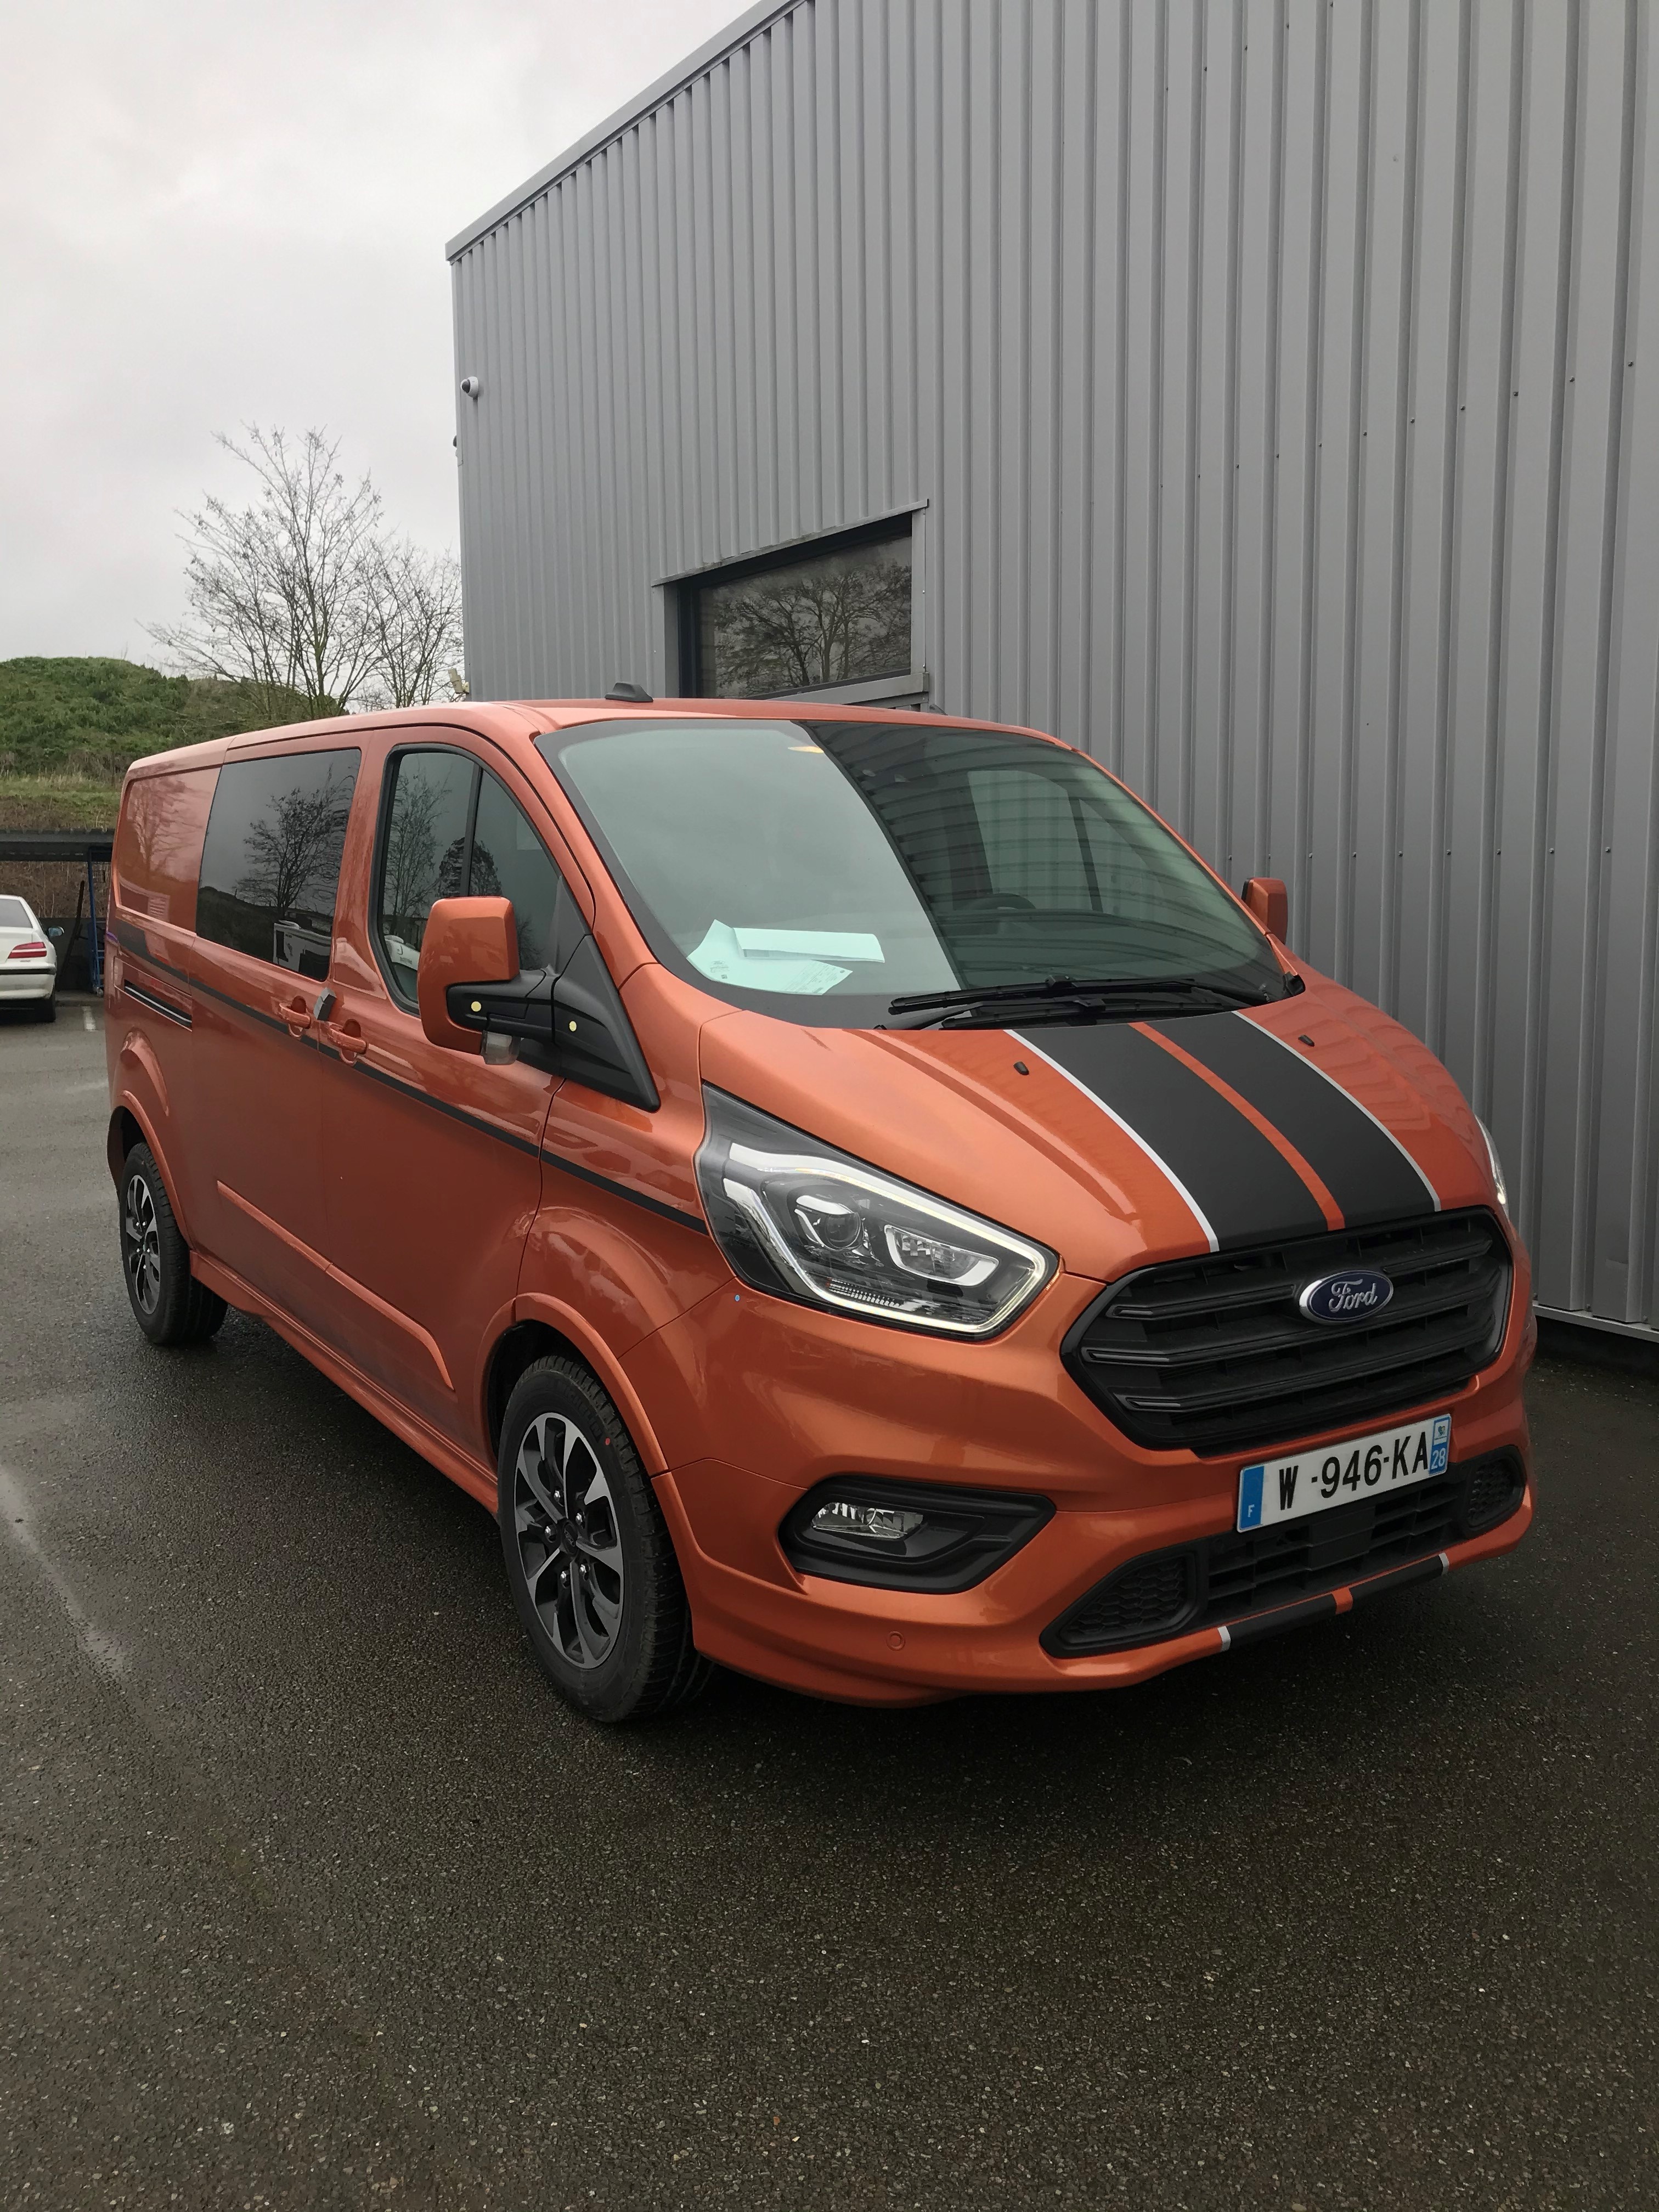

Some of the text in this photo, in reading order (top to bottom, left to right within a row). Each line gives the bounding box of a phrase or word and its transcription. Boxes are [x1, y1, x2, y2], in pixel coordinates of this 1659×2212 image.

[1328, 1279, 1378, 1313] Ford
[1431, 1447, 1446, 1470] 28
[1247, 1504, 1256, 1519] F
